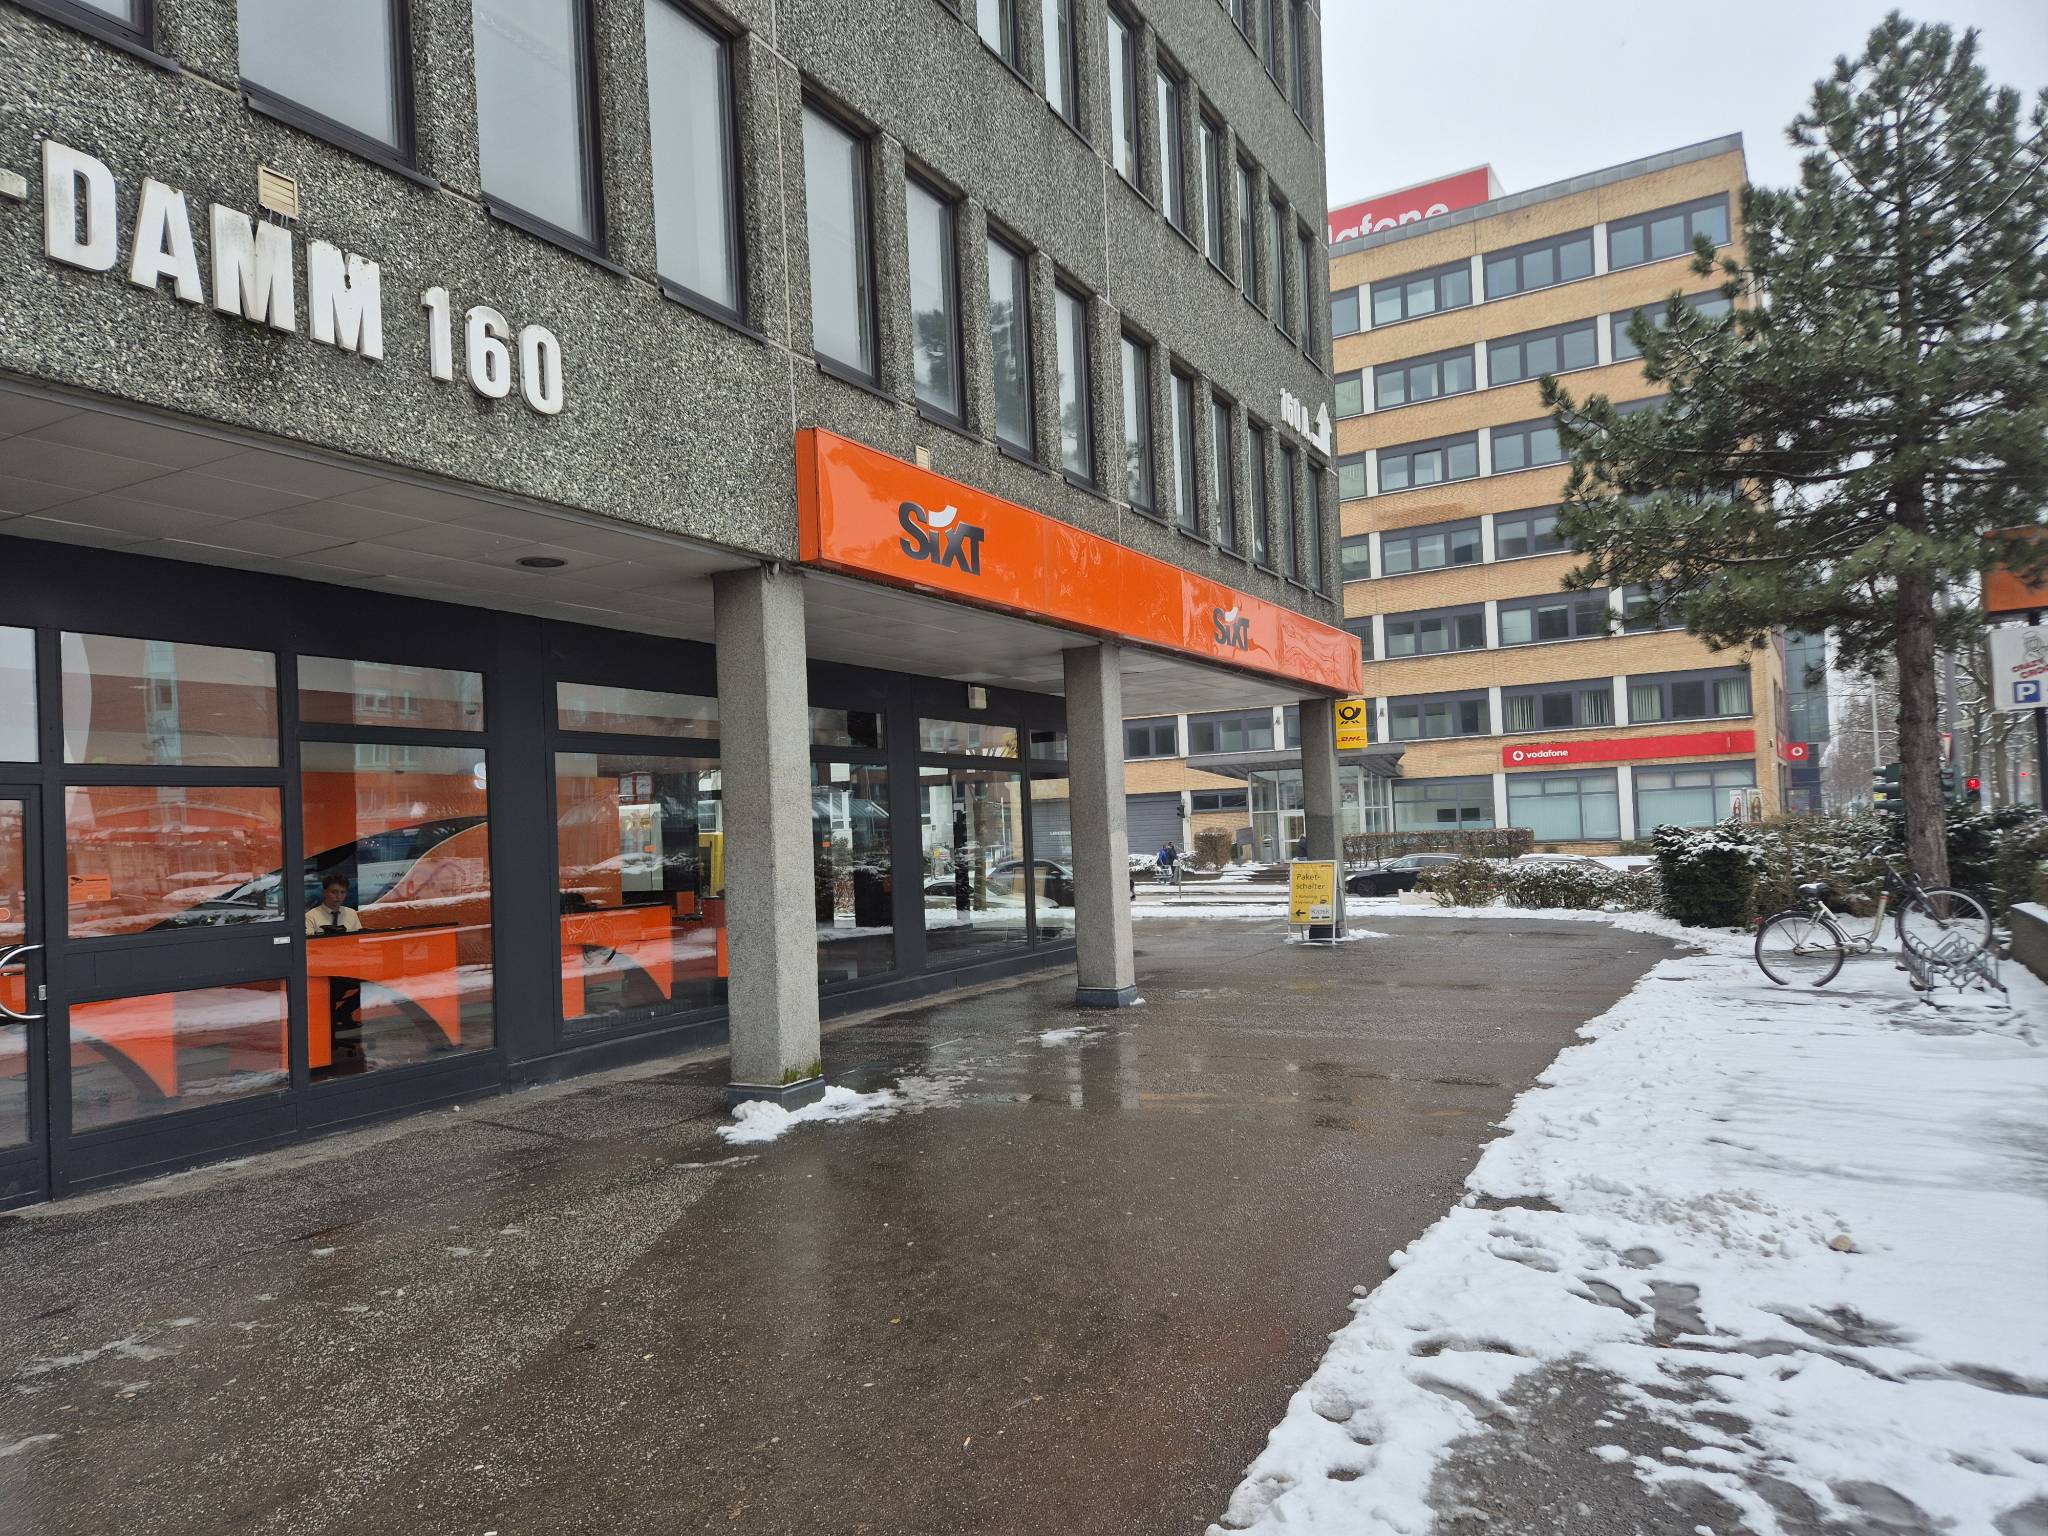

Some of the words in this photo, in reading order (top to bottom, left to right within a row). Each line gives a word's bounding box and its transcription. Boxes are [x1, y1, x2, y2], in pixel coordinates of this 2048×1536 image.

[420, 286, 563, 416] 160
[2016, 682, 2037, 702] P
[1526, 749, 1569, 759] vodafone
[1296, 873, 1321, 881] Paket-
[1295, 882, 1326, 890] schalter
